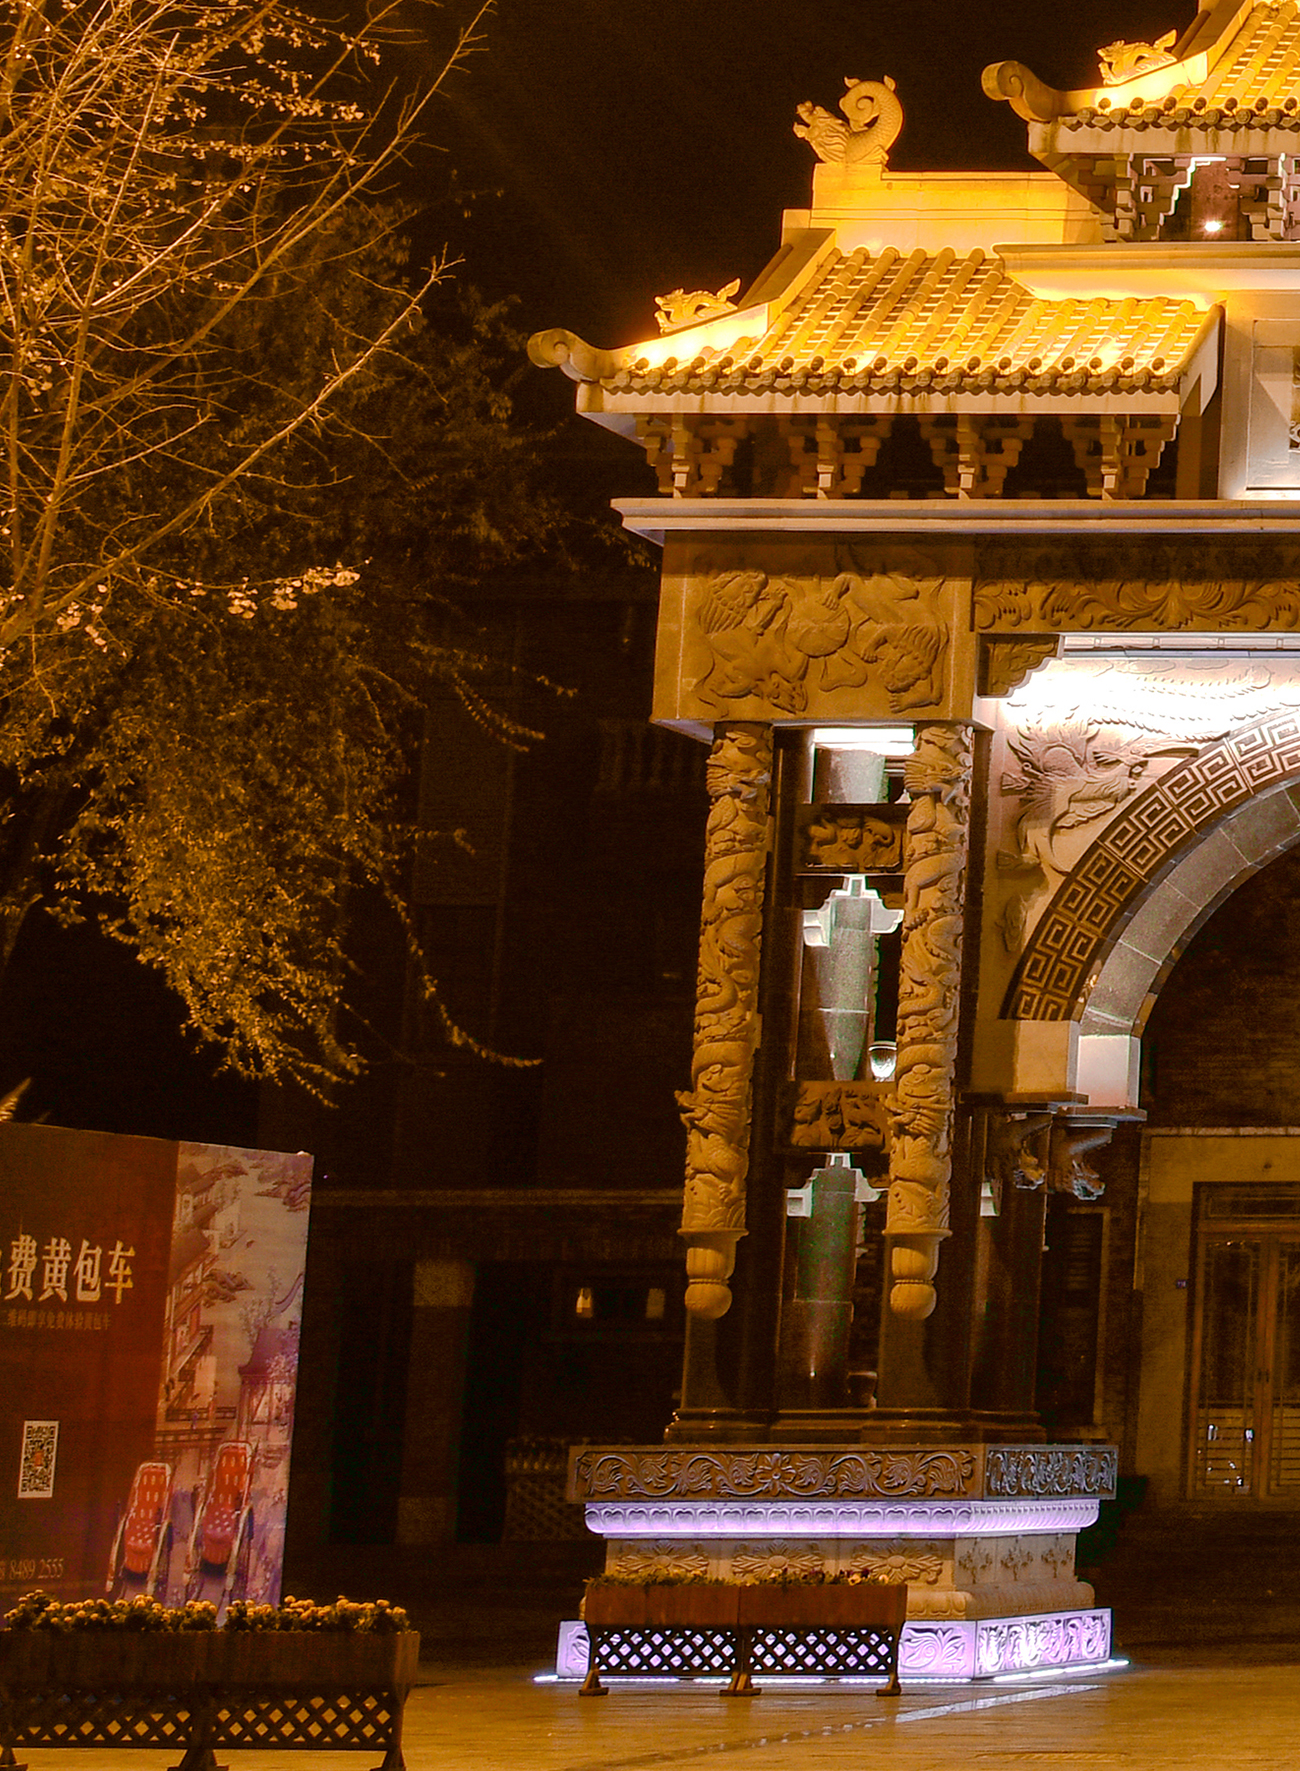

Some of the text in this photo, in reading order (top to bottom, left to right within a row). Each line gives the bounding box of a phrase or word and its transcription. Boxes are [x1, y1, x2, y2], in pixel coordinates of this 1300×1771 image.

[0, 1233, 136, 1305] 费黄包车
[9, 1559, 36, 1580] 8489
[38, 1558, 64, 1579] 2555
